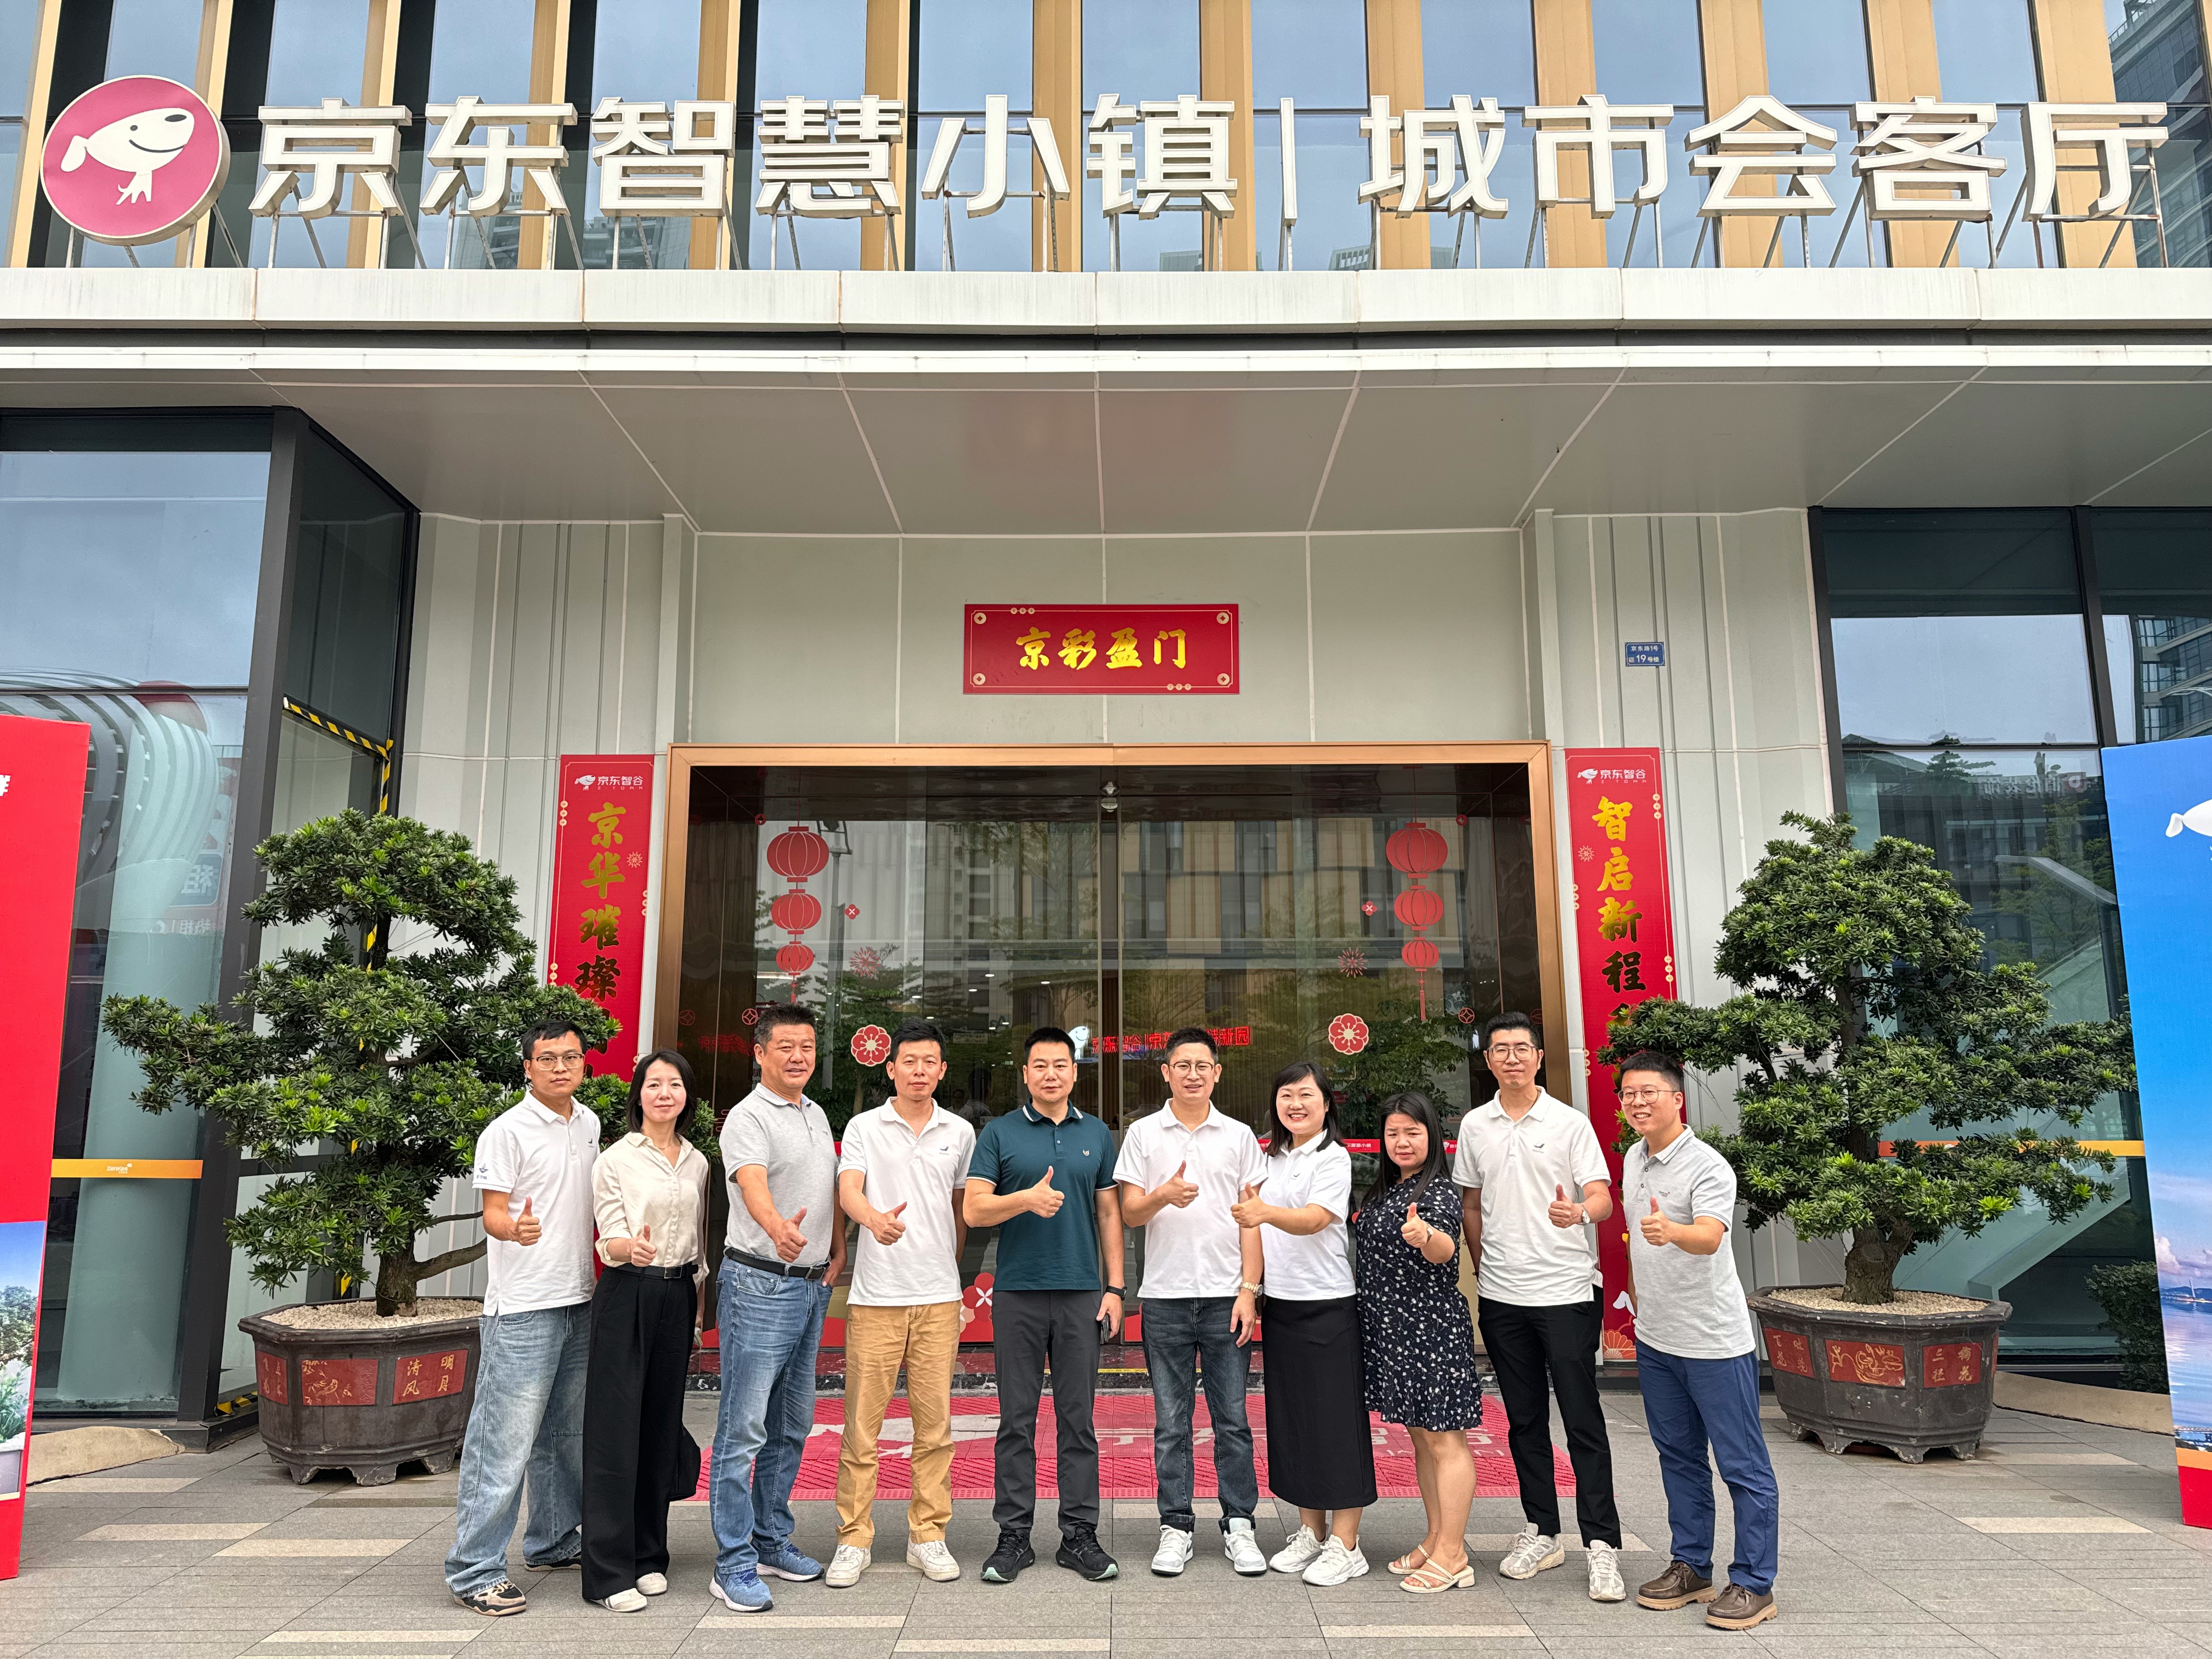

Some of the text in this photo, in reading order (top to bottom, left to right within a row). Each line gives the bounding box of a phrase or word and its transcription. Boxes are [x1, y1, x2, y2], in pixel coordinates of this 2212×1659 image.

[249, 93, 2170, 223] 京东智慧小镇 城市会客厅
[1015, 627, 1187, 670] 京彩盈门
[597, 775, 644, 786] 京东智谷
[1600, 769, 1646, 779] 京东智谷
[574, 802, 627, 1078] 京华璀璨
[1592, 795, 1646, 1095] 智启新程
